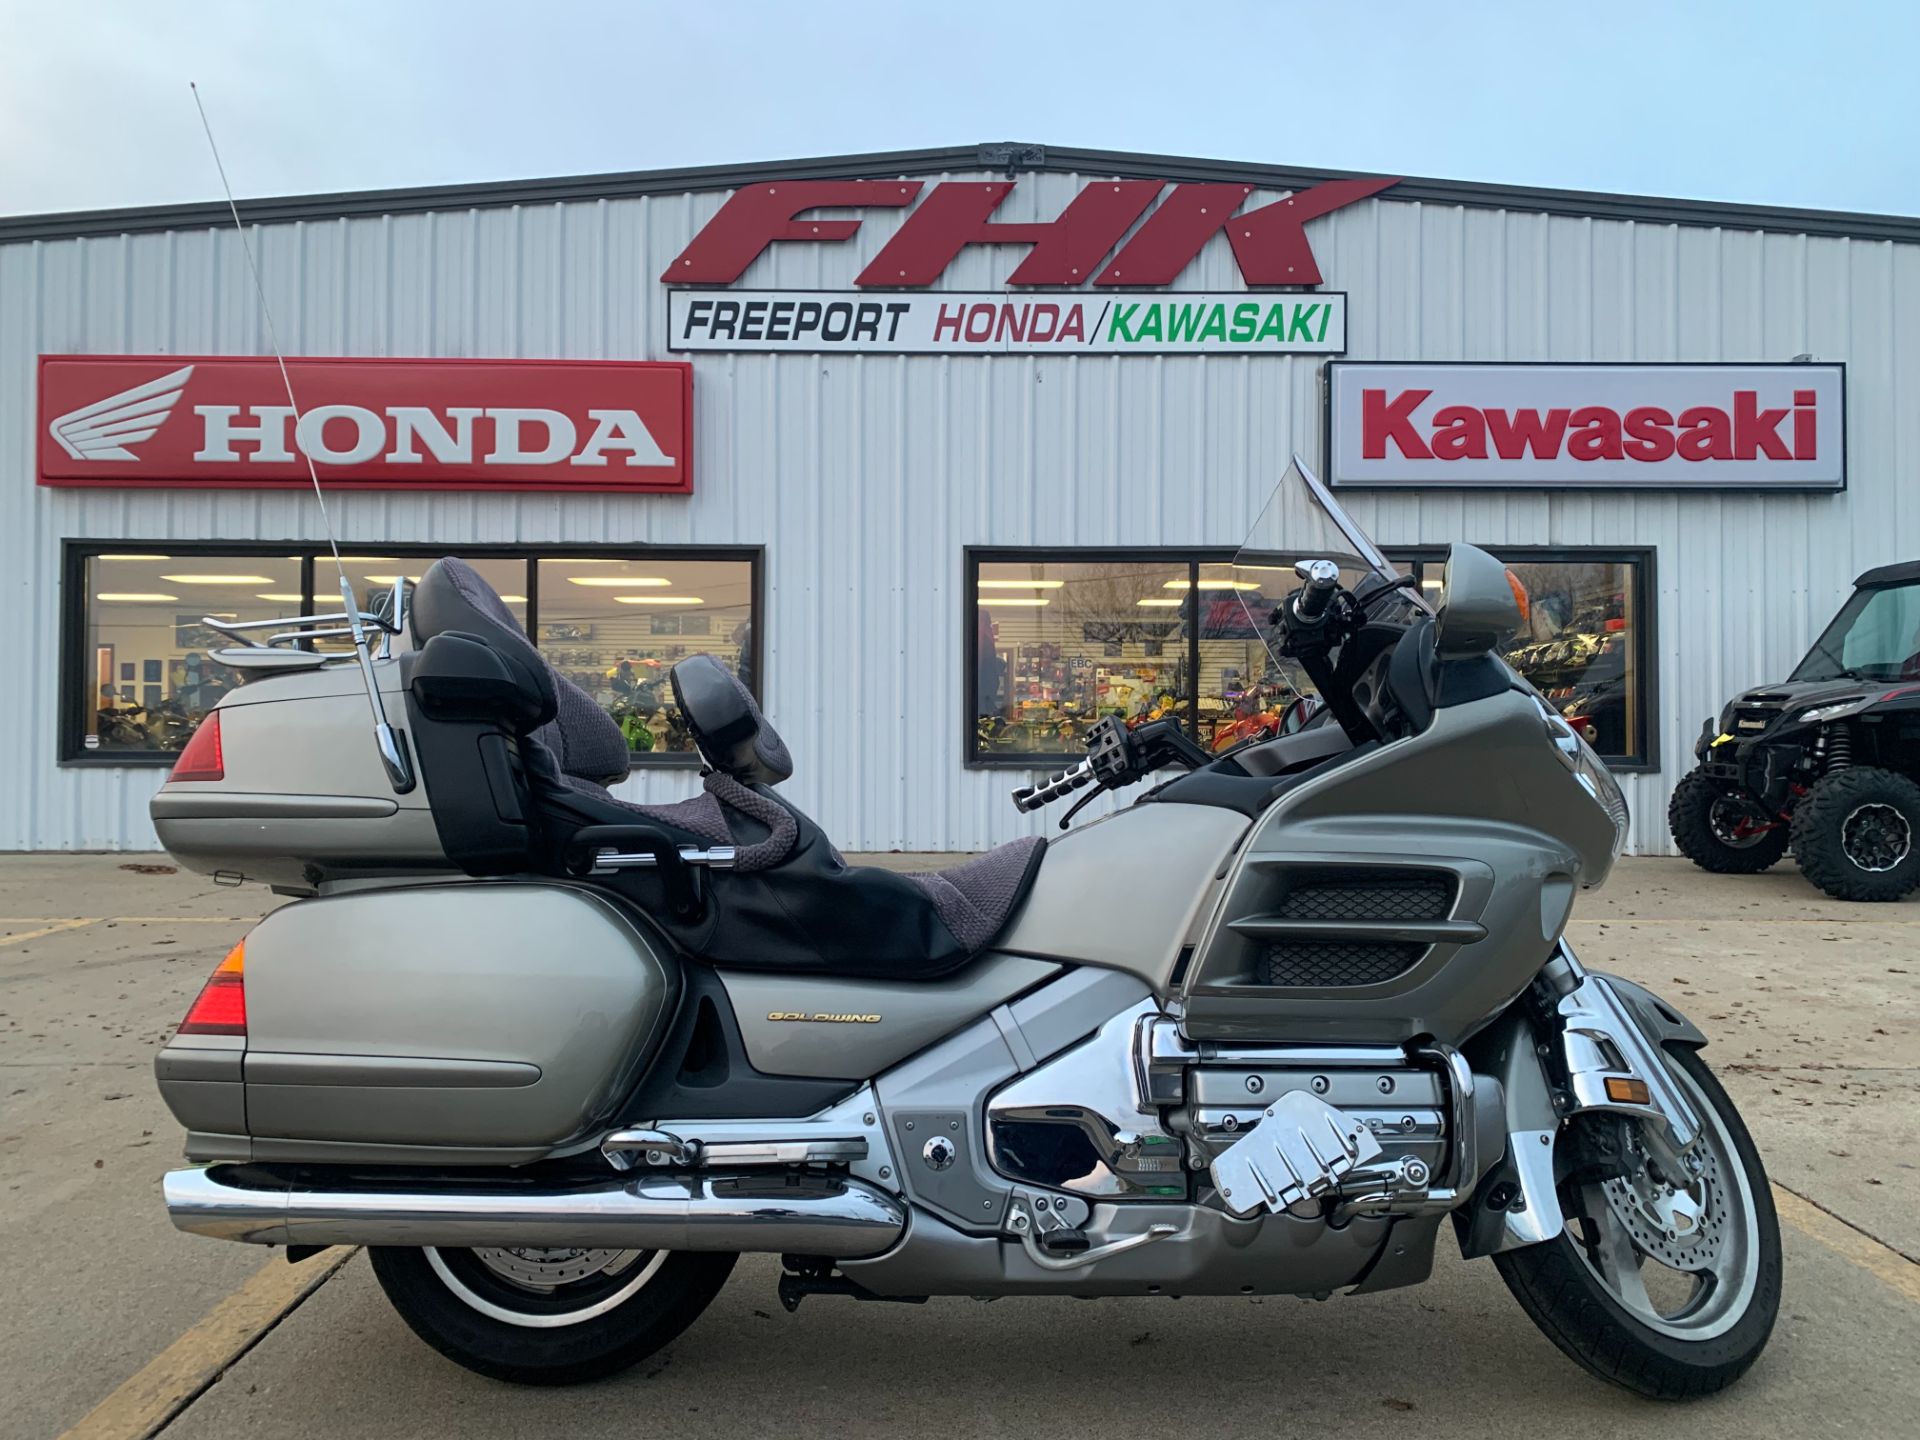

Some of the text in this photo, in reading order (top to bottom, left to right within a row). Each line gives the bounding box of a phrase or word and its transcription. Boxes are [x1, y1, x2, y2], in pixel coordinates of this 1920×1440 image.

[661, 179, 1398, 286] FHK
[683, 300, 911, 342] FREEPORT
[193, 403, 676, 467] HONDA
[1362, 388, 1817, 463] Kawasaki
[1070, 658, 1093, 669] EBC
[767, 1011, 882, 1024] GOLDWING
